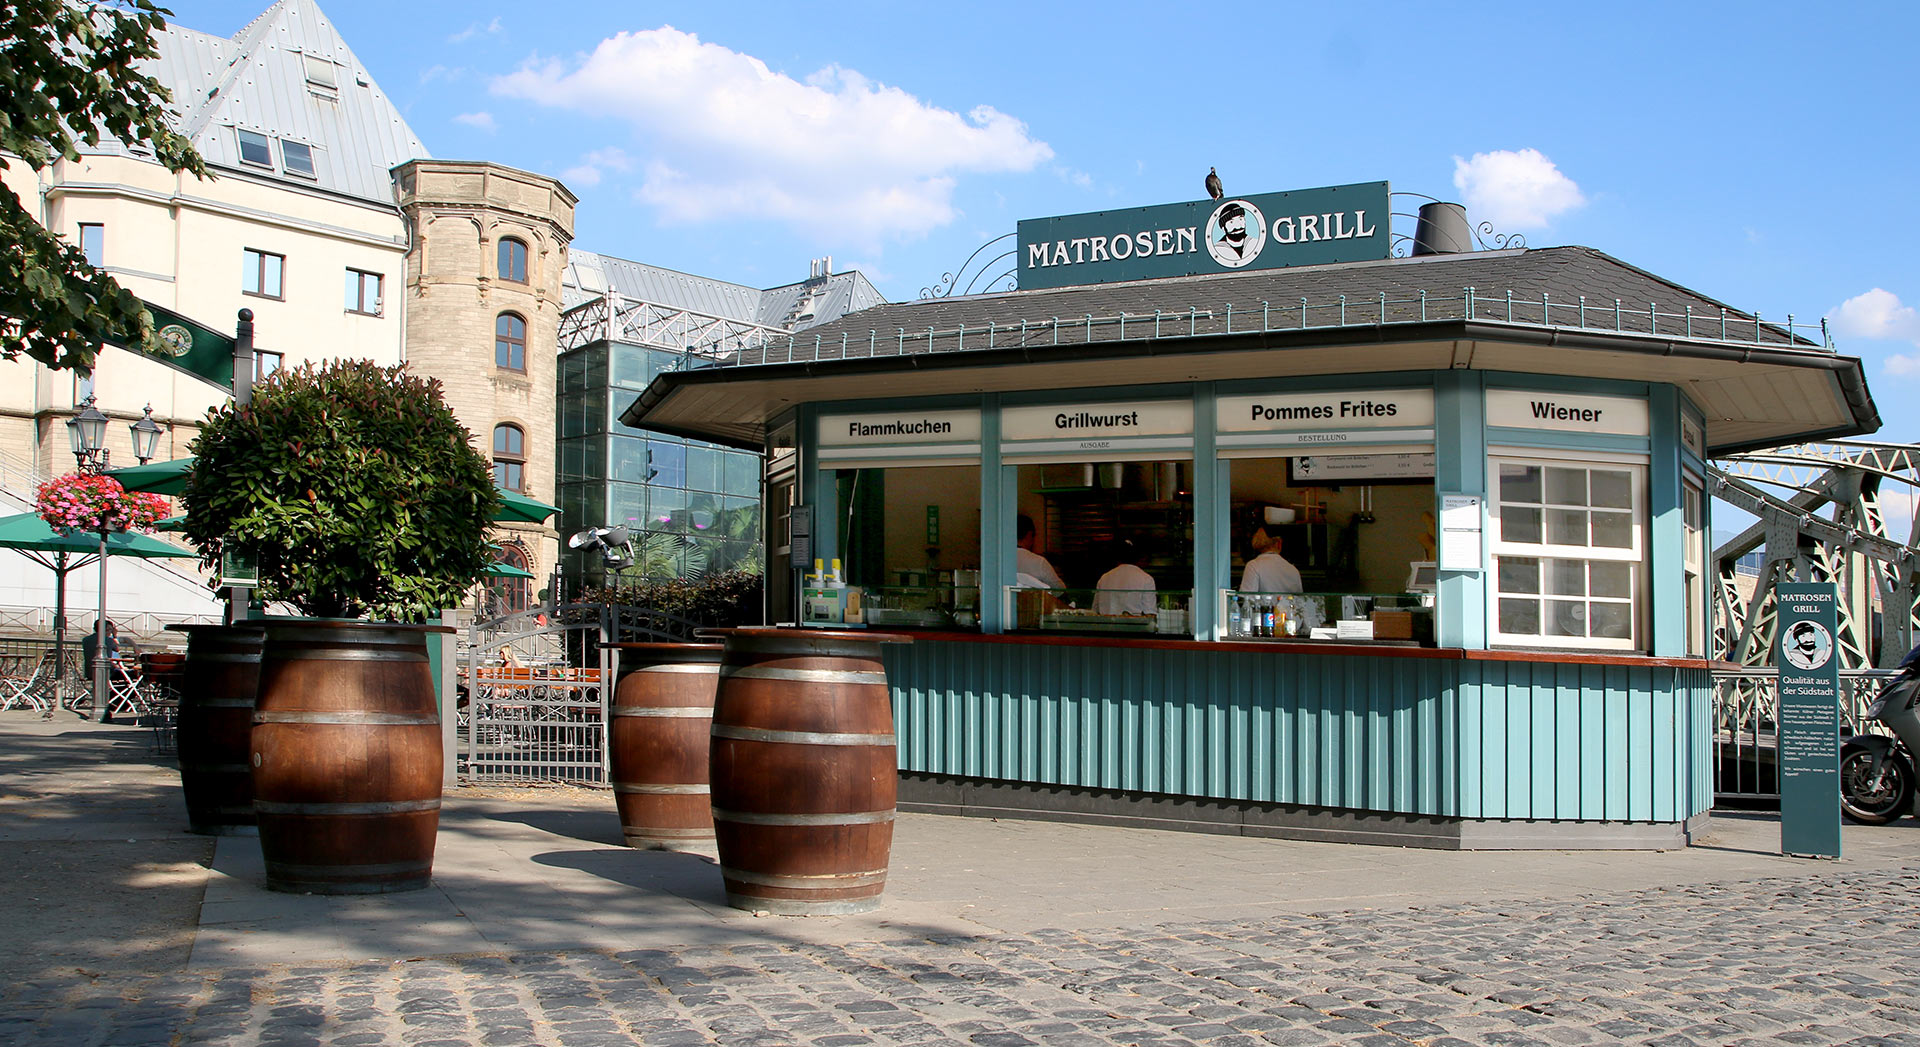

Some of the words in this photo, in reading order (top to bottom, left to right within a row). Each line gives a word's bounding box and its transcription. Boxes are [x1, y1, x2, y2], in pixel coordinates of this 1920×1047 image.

[1028, 226, 1198, 269] MATROSEN
[1273, 210, 1376, 244] GRILL
[1252, 405, 1333, 421] Pommes
[1341, 401, 1397, 417] Frites
[1531, 402, 1602, 423] Wiener
[1055, 411, 1137, 429] Grillwurst
[849, 419, 951, 437] Flammkuchen
[1297, 433, 1347, 442] BESTELLUNG
[1079, 441, 1110, 449] AUSGABE
[1781, 593, 1832, 602] MATROSEN
[1793, 605, 1821, 613] GRILL
[1783, 676, 1814, 685] Qualität
[1783, 687, 1796, 695] der
[1798, 687, 1834, 696] Südstadt
